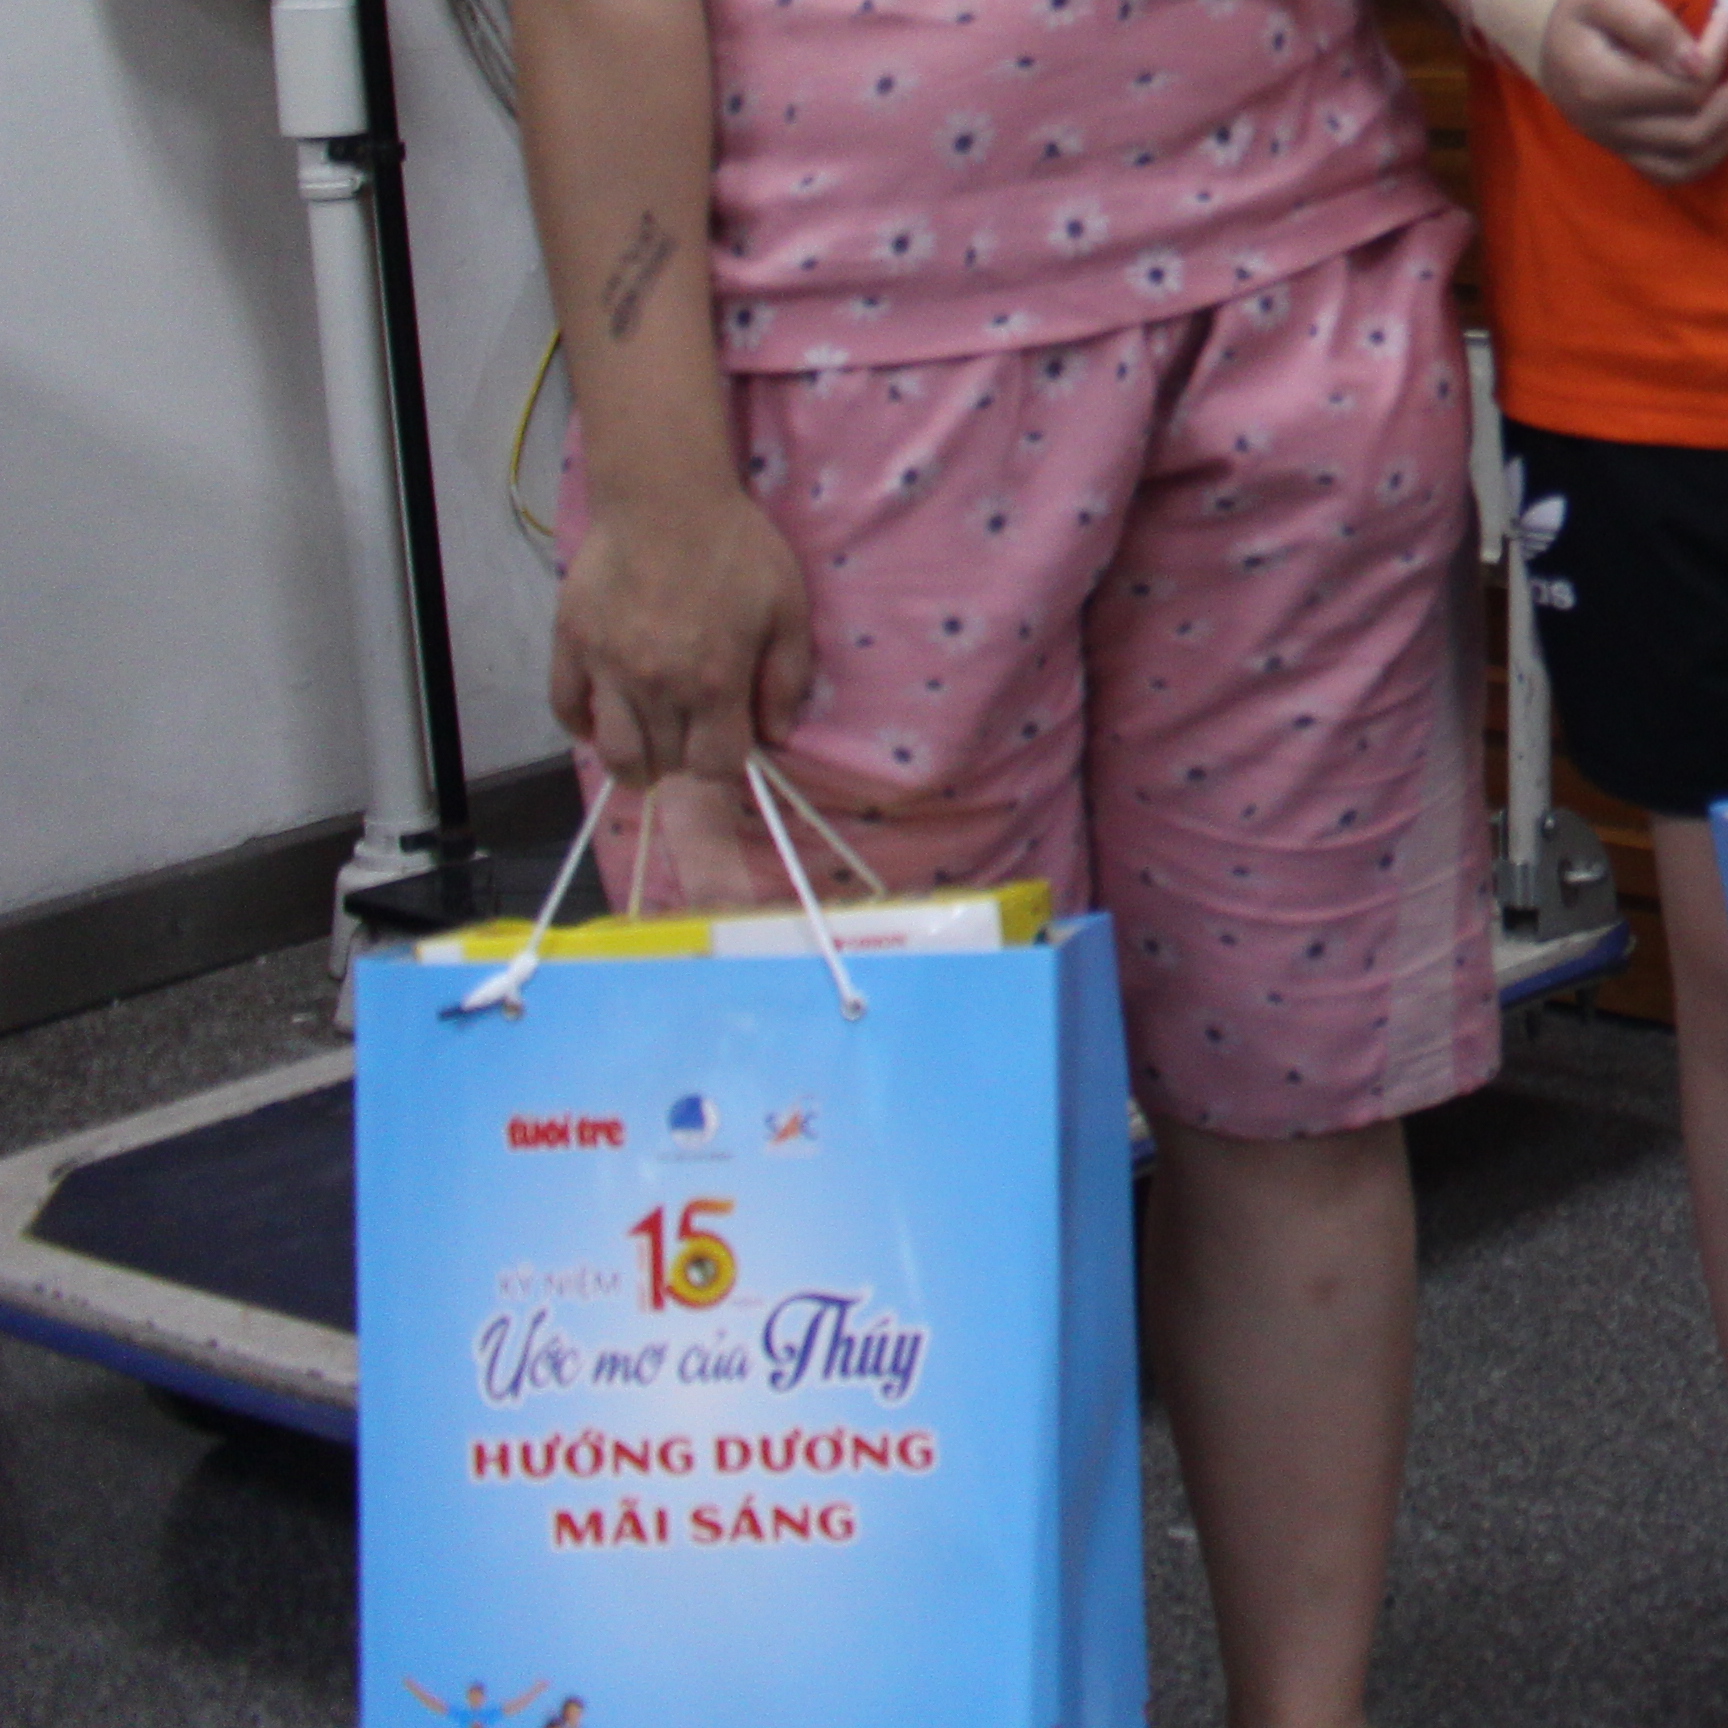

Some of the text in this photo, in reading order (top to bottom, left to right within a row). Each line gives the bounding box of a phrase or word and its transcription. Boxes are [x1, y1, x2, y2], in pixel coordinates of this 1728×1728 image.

[629, 1199, 738, 1312] 15
[679, 1327, 749, 1384] của
[764, 1292, 923, 1401] Thúy
[473, 1426, 936, 1480] HƯỚNG DƯƠNG
[554, 1493, 855, 1547] MÃI SÁNG
